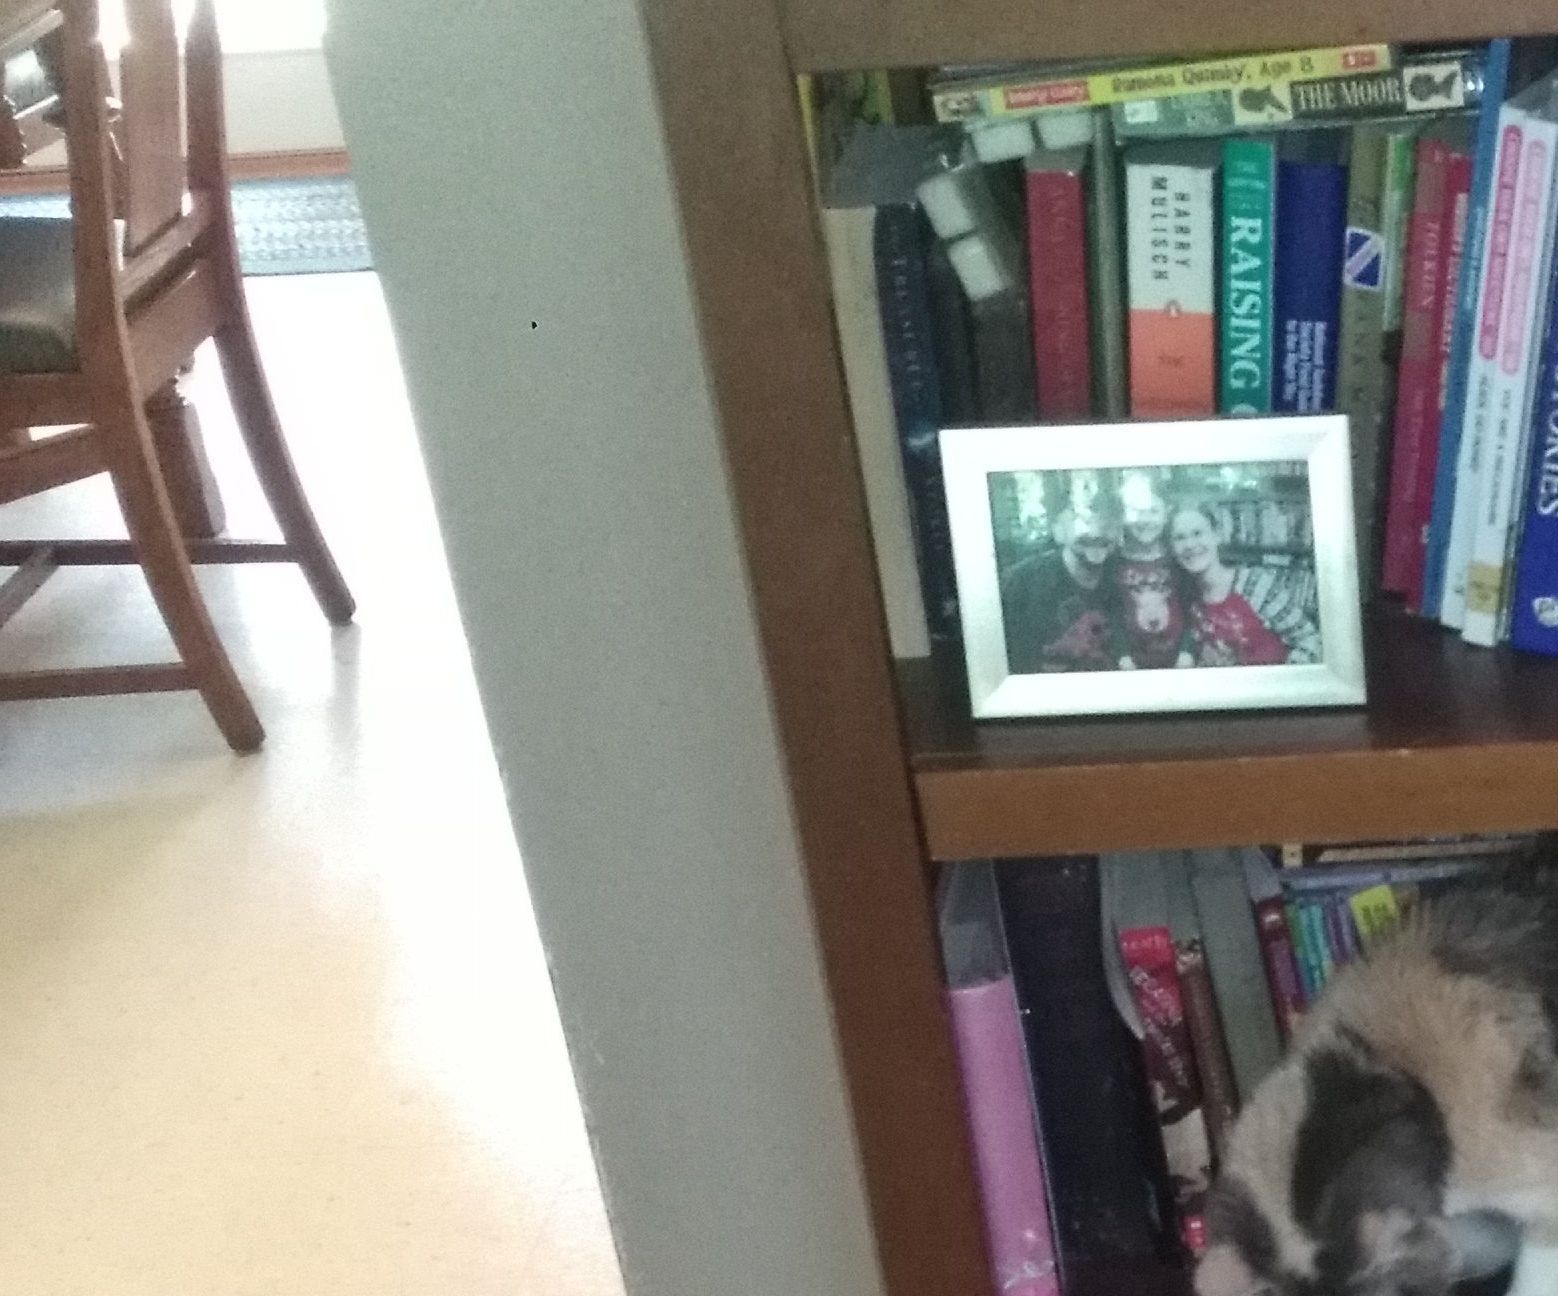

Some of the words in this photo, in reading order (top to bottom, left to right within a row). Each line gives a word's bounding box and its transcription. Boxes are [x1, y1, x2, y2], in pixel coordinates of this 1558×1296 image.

[1151, 176, 1169, 282] MULISCH
[1174, 191, 1191, 269] HARRY
[1228, 215, 1262, 389] RAISING
